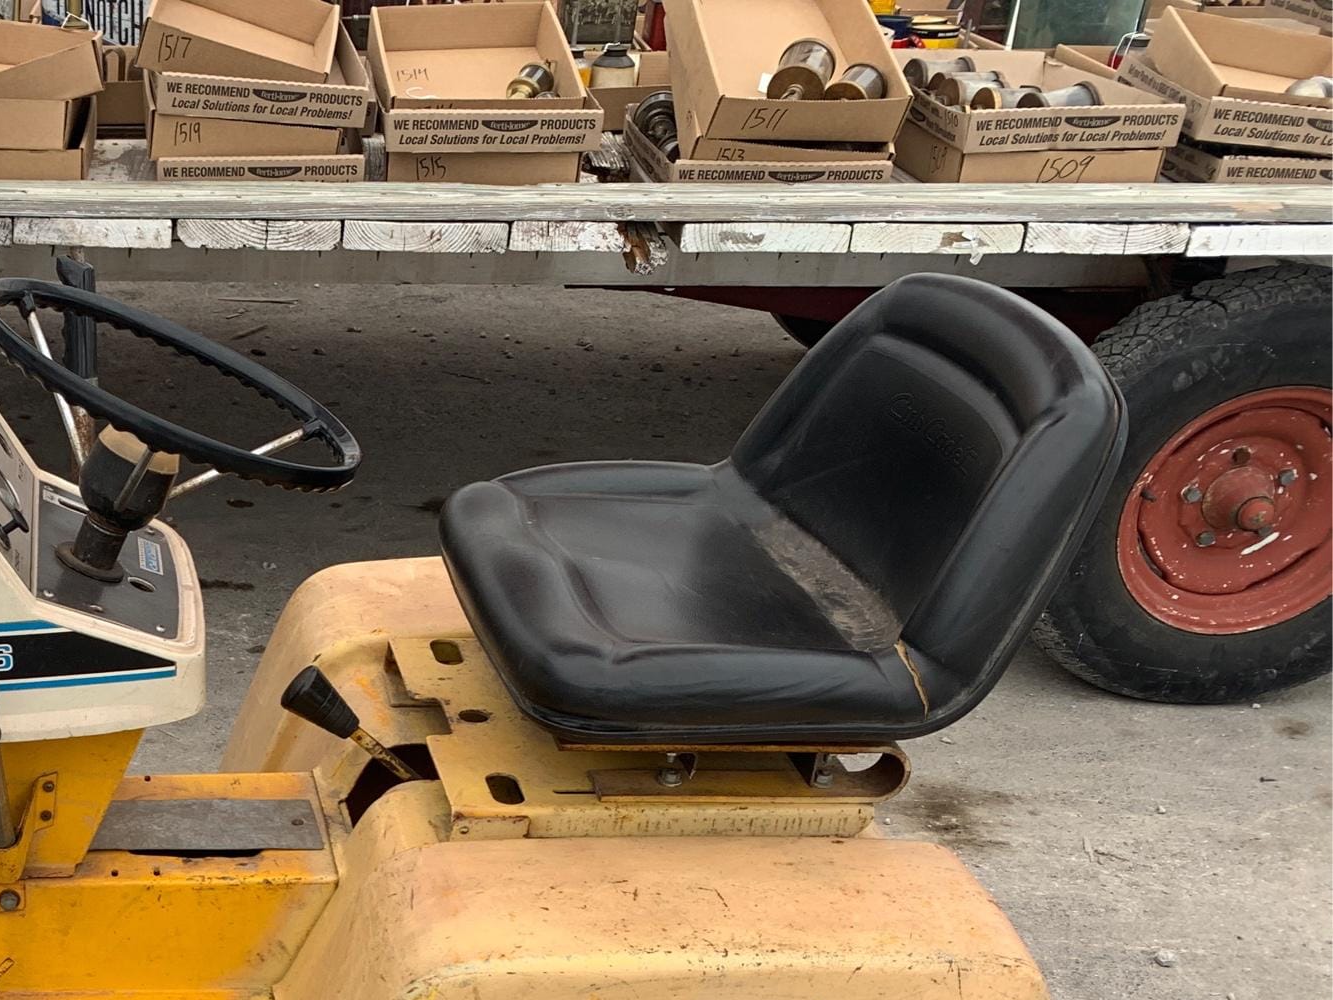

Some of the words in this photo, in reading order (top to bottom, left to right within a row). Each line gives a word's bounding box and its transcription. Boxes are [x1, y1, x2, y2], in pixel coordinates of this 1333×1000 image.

[157, 32, 192, 62] 1517
[166, 82, 183, 94] WE
[185, 83, 251, 98] RECOMMEND
[309, 93, 363, 107] PRODUCTS
[171, 97, 199, 109] Local
[201, 99, 250, 113] Solutions
[252, 103, 267, 114] for
[269, 104, 298, 116] Local
[300, 107, 354, 120] Problems!
[1213, 108, 1231, 120] WE
[1232, 110, 1305, 128] RECOMMEND
[394, 119, 410, 130] WE
[412, 119, 479, 130] RECOMMEND
[540, 118, 596, 129] PRODUCTS
[741, 108, 789, 131] 1511
[976, 120, 992, 131] WE
[994, 116, 1062, 130] RECOMMEND
[1122, 114, 1179, 126] PRODUCTS
[173, 121, 201, 146] 1519
[399, 134, 427, 145] Local
[430, 134, 479, 145] Solutions
[482, 133, 497, 145] for
[499, 133, 529, 144] Local
[530, 133, 586, 144] Problems!
[979, 134, 1008, 146] Local
[1010, 132, 1059, 145] Solutions
[1061, 131, 1077, 143] for
[1079, 130, 1108, 142] Local
[1110, 129, 1166, 142] Problems!
[1213, 124, 1248, 137] Local
[1247, 126, 1301, 143] Solutions
[1302, 132, 1320, 145] for
[163, 167, 178, 178] WE
[180, 166, 245, 177] RECOMMEND
[304, 165, 358, 176] PRODUCTS
[416, 156, 447, 180] 1515
[679, 170, 695, 180] WE
[697, 170, 765, 181] RECOMMEND
[826, 170, 884, 181] PRODUCTS
[1036, 155, 1096, 183] 1509
[1226, 166, 1244, 178] WE
[1245, 167, 1316, 179] RECOMMEND
